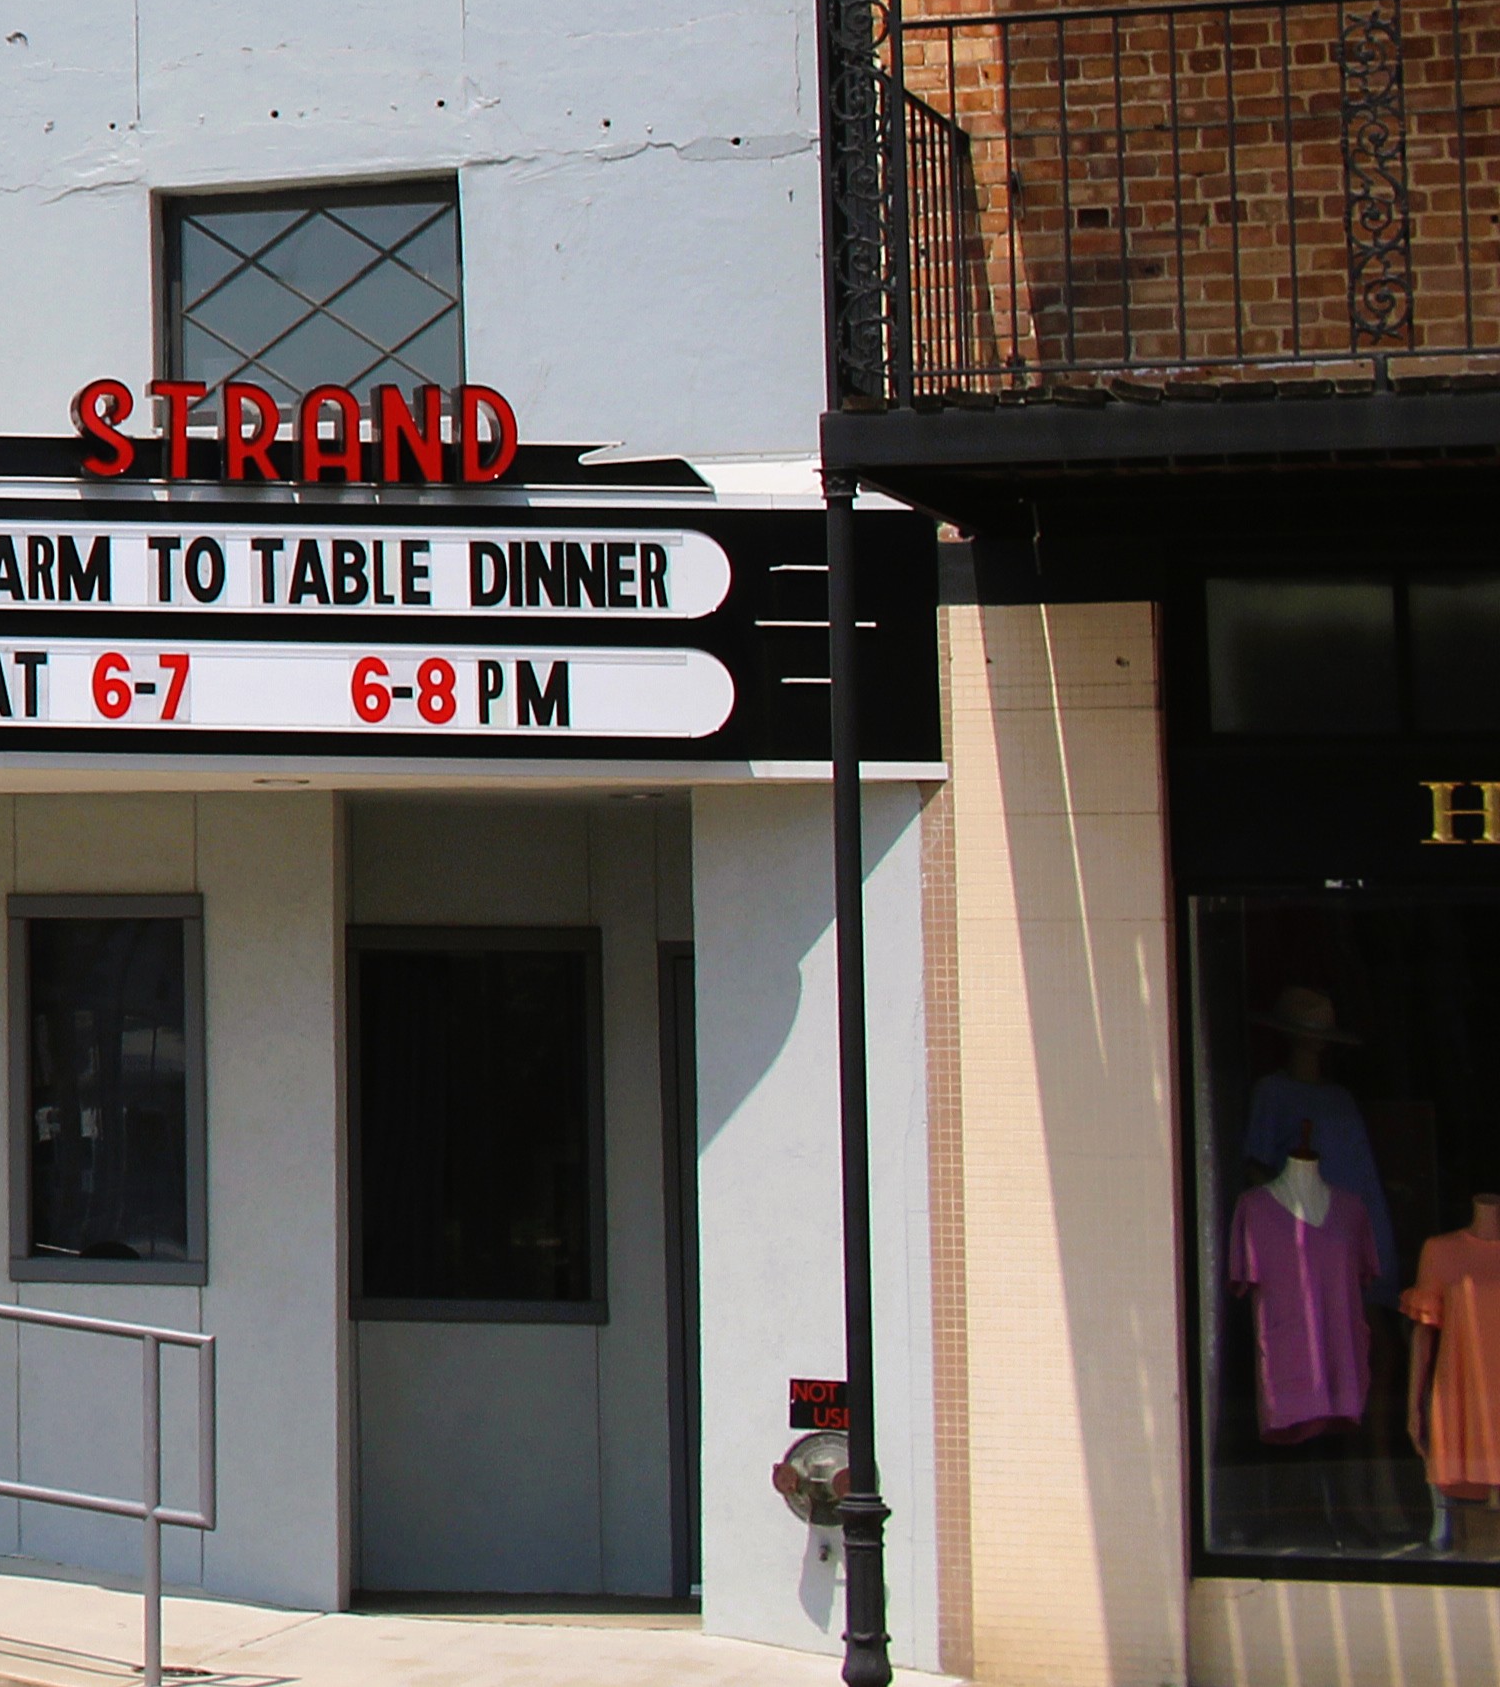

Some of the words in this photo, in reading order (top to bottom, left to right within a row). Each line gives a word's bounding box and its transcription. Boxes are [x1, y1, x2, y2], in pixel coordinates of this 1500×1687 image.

[79, 379, 517, 483] STRAND
[147, 537, 226, 603] TO
[251, 537, 431, 606] TABLE
[469, 542, 669, 608] DINNER
[91, 652, 190, 720] 6-7
[351, 656, 457, 724] 6-8
[479, 660, 570, 727] PM
[793, 1382, 838, 1402] NOT
